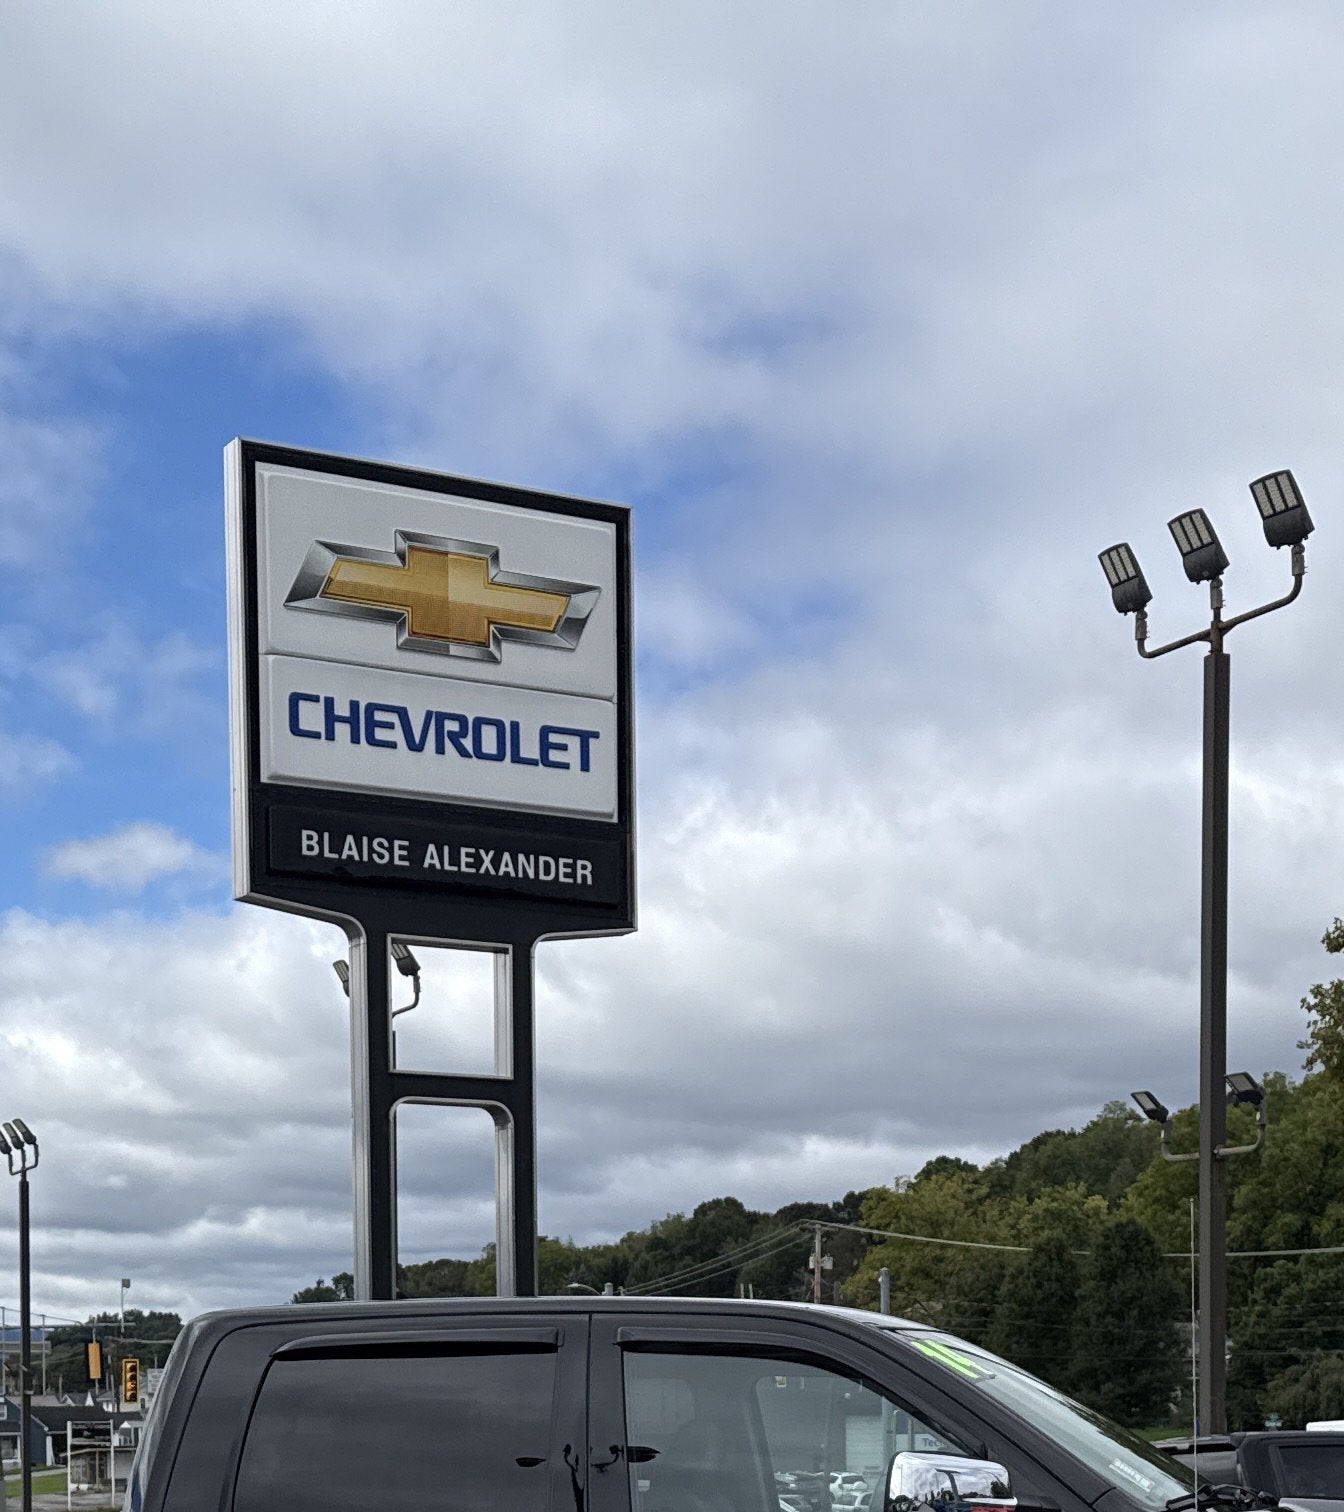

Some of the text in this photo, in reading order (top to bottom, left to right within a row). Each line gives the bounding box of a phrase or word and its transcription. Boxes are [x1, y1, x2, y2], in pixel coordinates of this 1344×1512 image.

[288, 691, 600, 773] CHEVROLET
[301, 829, 594, 885] BLAISE ALEXANDER
